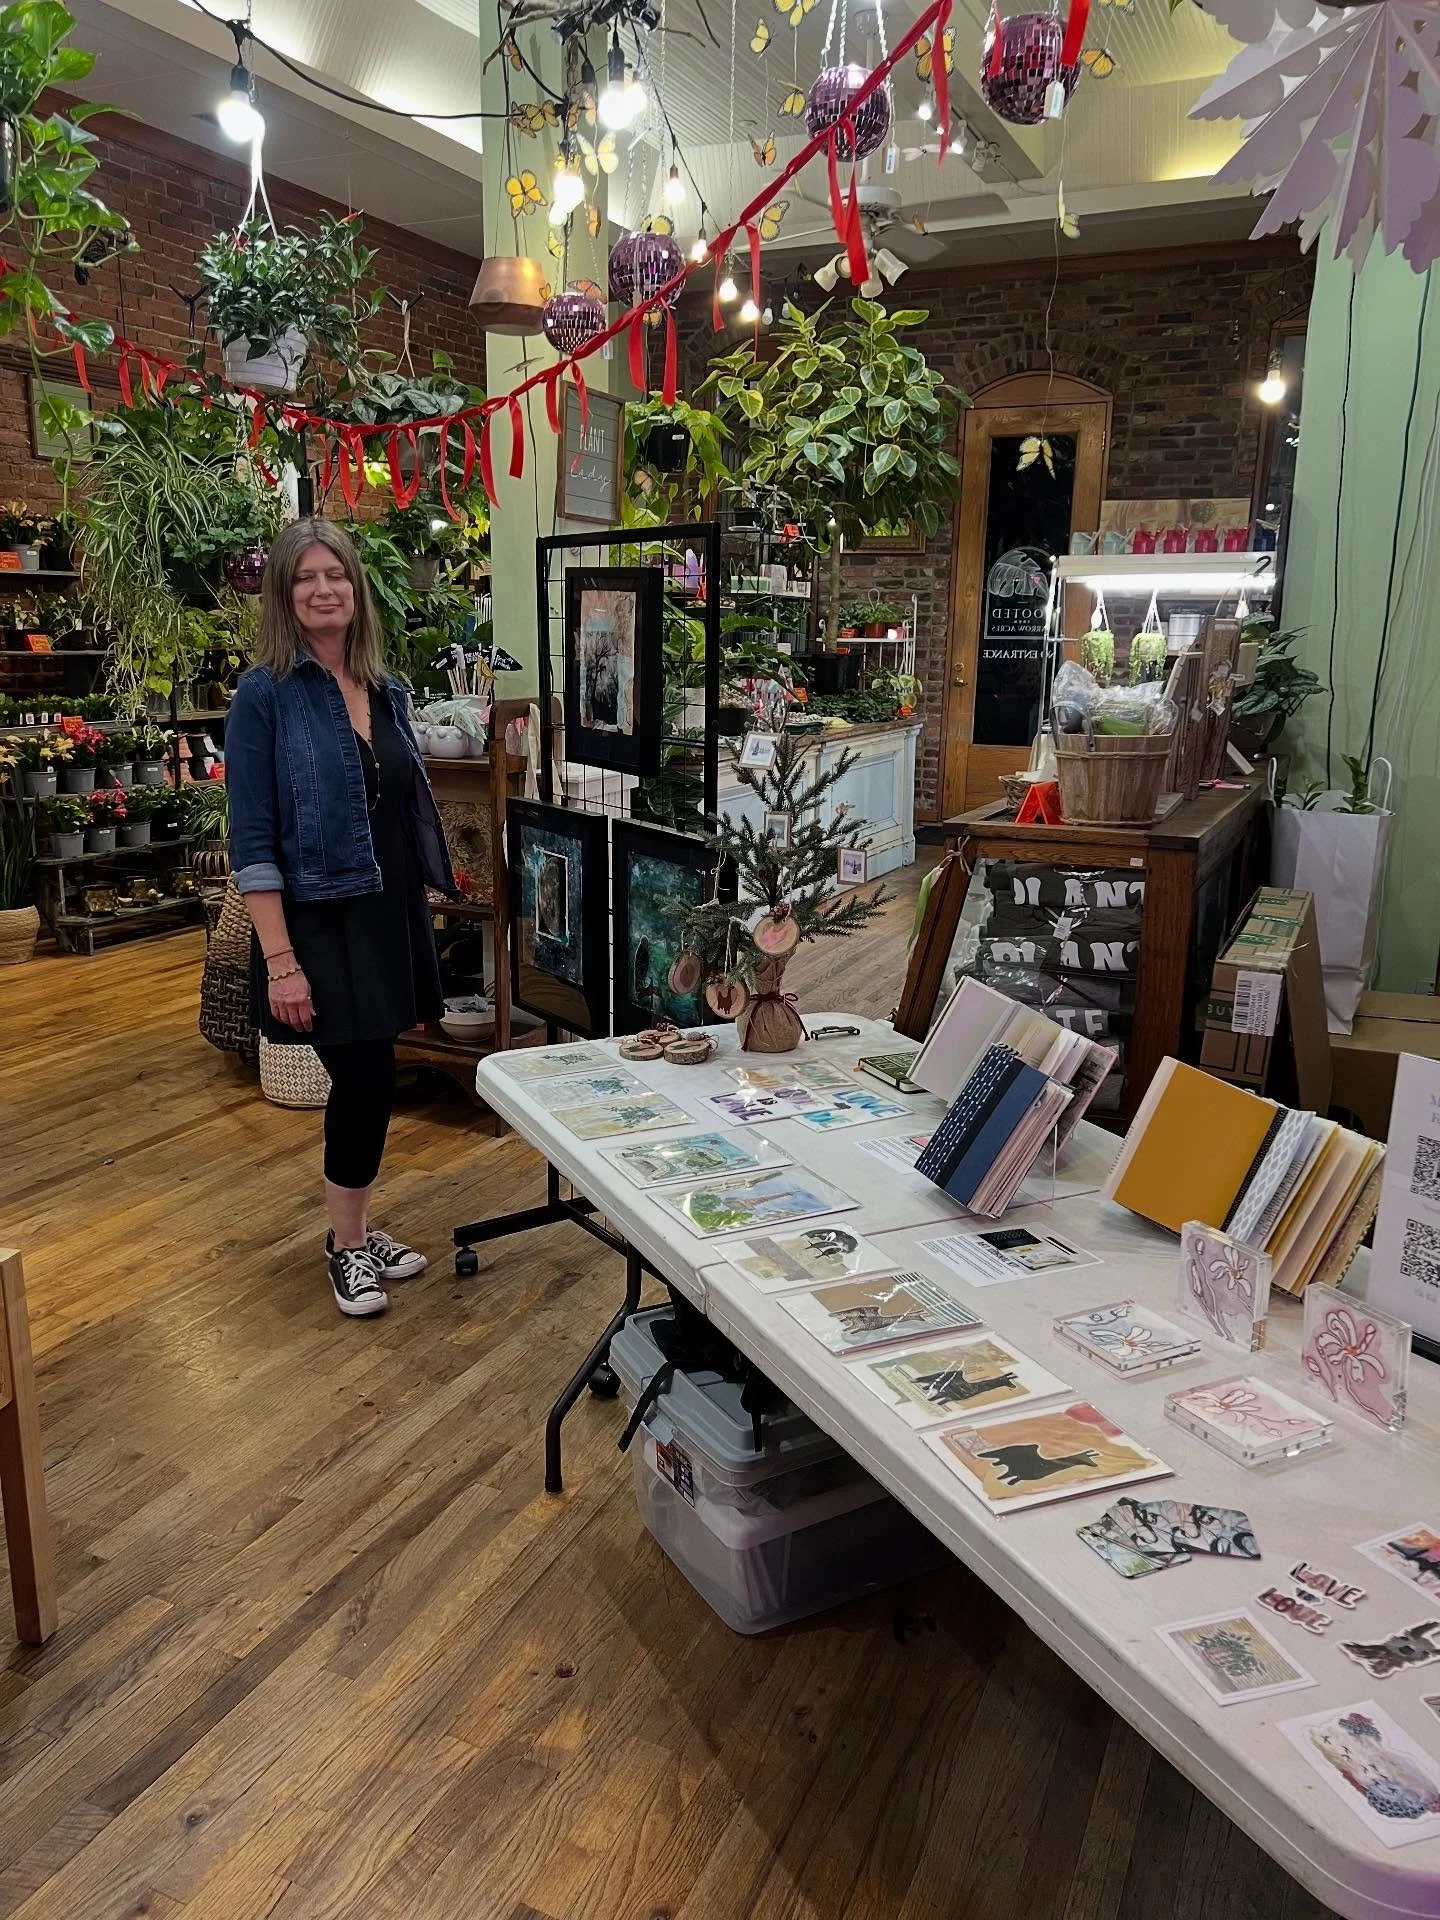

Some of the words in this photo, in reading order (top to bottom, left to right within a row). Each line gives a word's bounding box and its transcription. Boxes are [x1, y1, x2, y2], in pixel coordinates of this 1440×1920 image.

[580, 424, 605, 454] PLANT
[832, 1089, 906, 1117] LOVE
[1290, 1562, 1362, 1606] LOVE
[1258, 1587, 1328, 1630] LOVE
